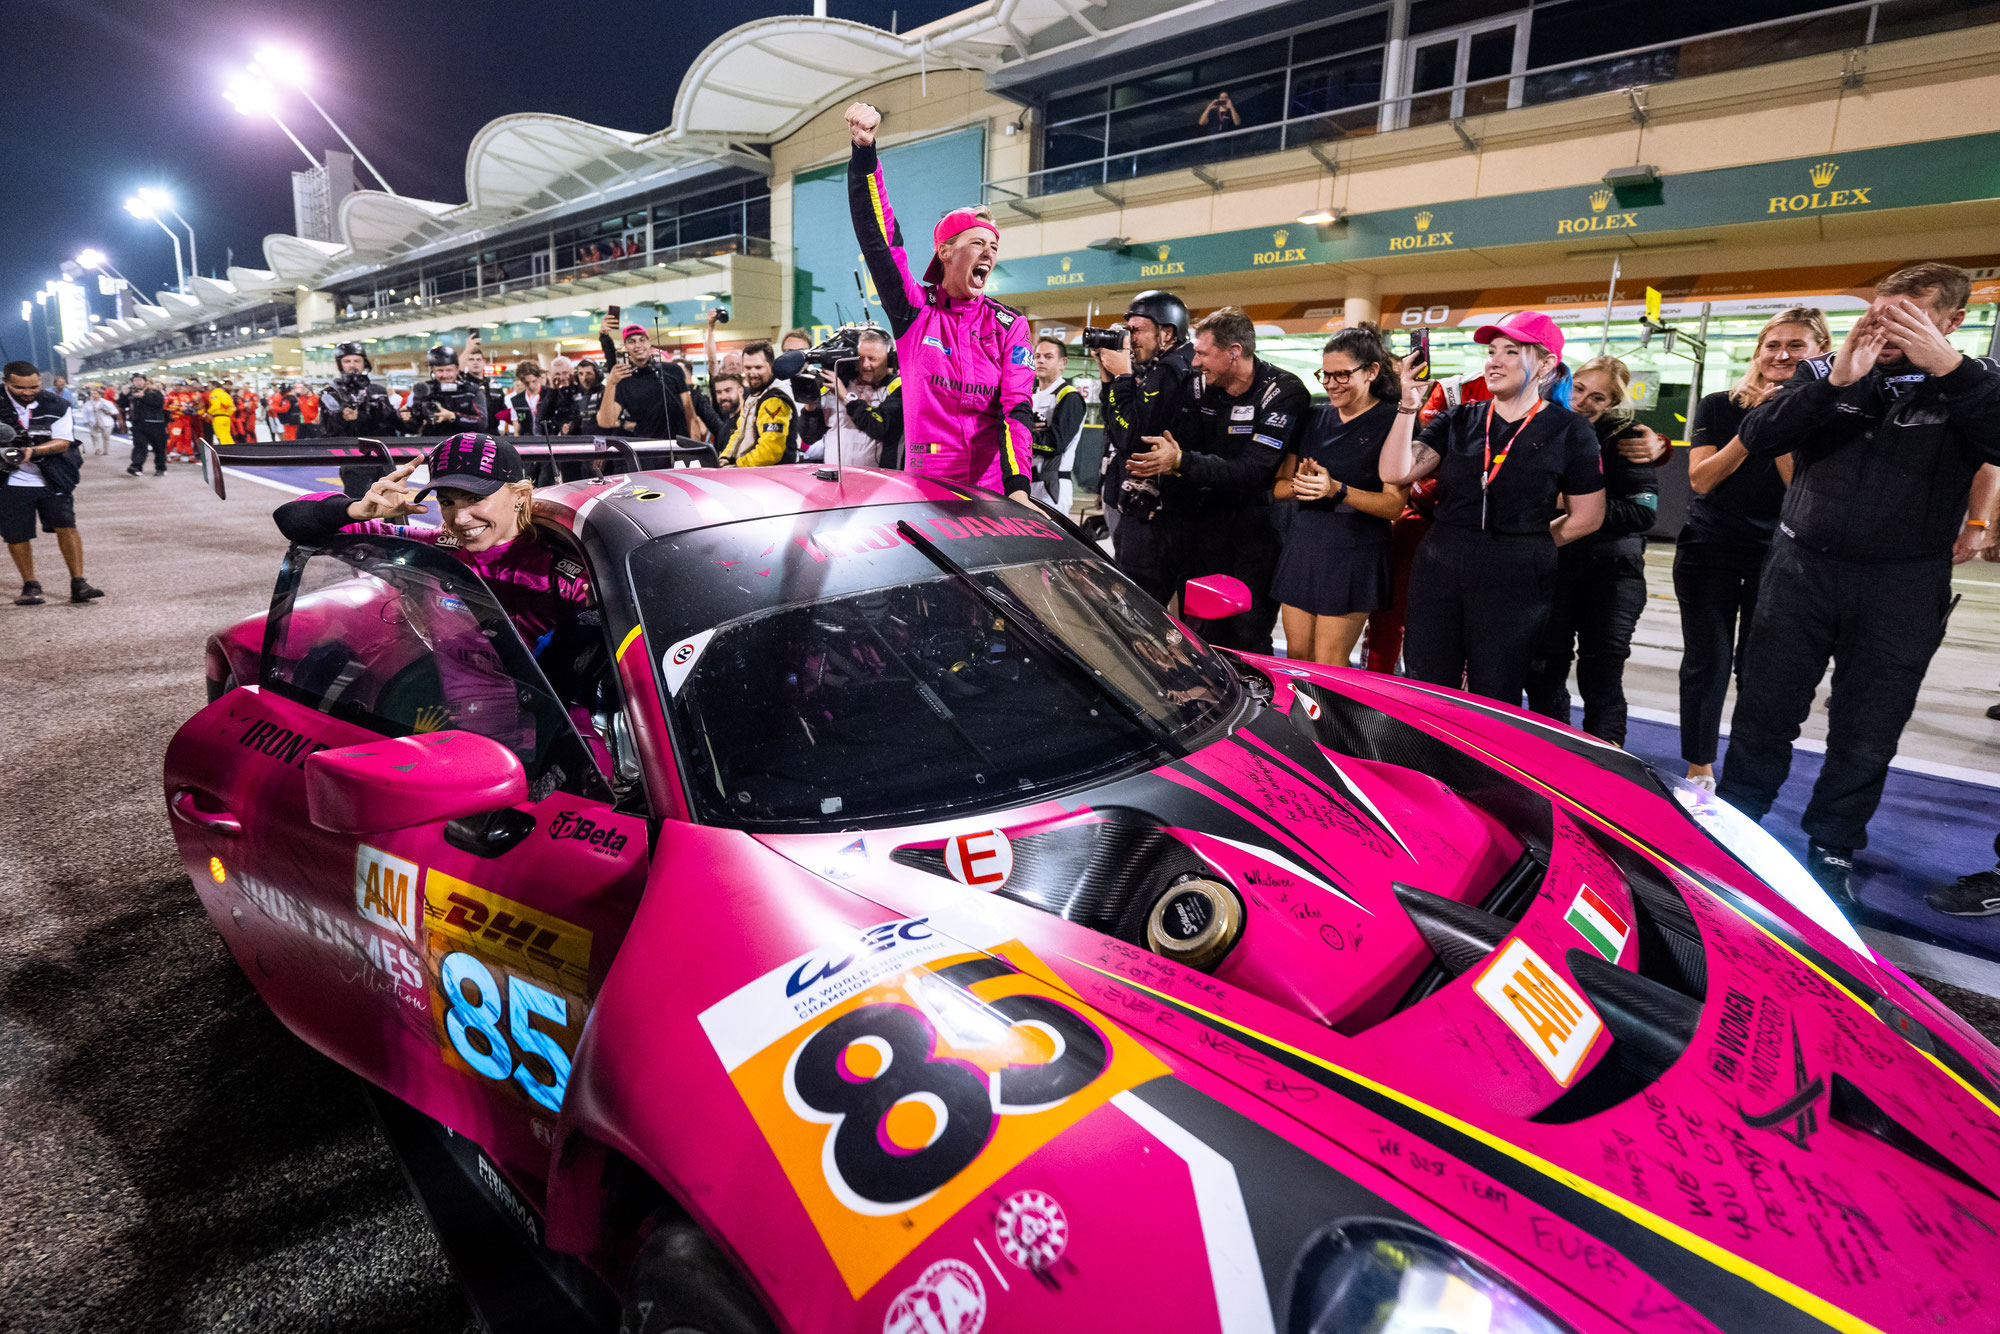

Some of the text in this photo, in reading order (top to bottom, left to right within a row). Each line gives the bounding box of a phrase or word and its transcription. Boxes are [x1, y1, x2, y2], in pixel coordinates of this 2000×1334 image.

[1767, 187, 1872, 214] ROLEX
[1389, 231, 1454, 251] ROLEX
[1556, 212, 1638, 235] ROLEX
[1141, 262, 1185, 277] ROLEX
[1253, 248, 1306, 265] ROLEX
[1047, 272, 1084, 286] ROLEX
[1400, 305, 1450, 326] 60
[930, 374, 962, 391] IRON
[480, 435, 498, 474] IRON
[910, 444, 925, 453] OMP
[910, 458, 924, 468] 85
[926, 516, 1064, 541] DAMES
[557, 560, 582, 575] OMP
[238, 719, 304, 765] IRON
[572, 819, 628, 851] Beta
[956, 830, 1003, 885] E
[364, 861, 408, 927] AM
[1243, 872, 1296, 888] Whatever
[240, 871, 423, 989] IRON DAMES
[444, 892, 566, 970] DHL
[794, 942, 946, 1012] FIA WORLD ENDURANCE
[1101, 939, 1140, 960] ROSS
[1147, 957, 1176, 977] WAS
[1502, 957, 1583, 1057] AM
[1715, 986, 1755, 1056] WOMEN
[442, 952, 572, 1112] 85
[1747, 994, 1785, 1098] IN MOTORSPORT
[783, 953, 1114, 1217] 85
[1712, 1053, 1738, 1081] FIA
[1642, 1088, 1714, 1217] WE LOVE
[478, 1153, 539, 1245] PRISMA
[1456, 1174, 1509, 1213] TEAM
[1713, 1181, 1761, 1240] YOU
[1530, 1216, 1627, 1281] EVER
